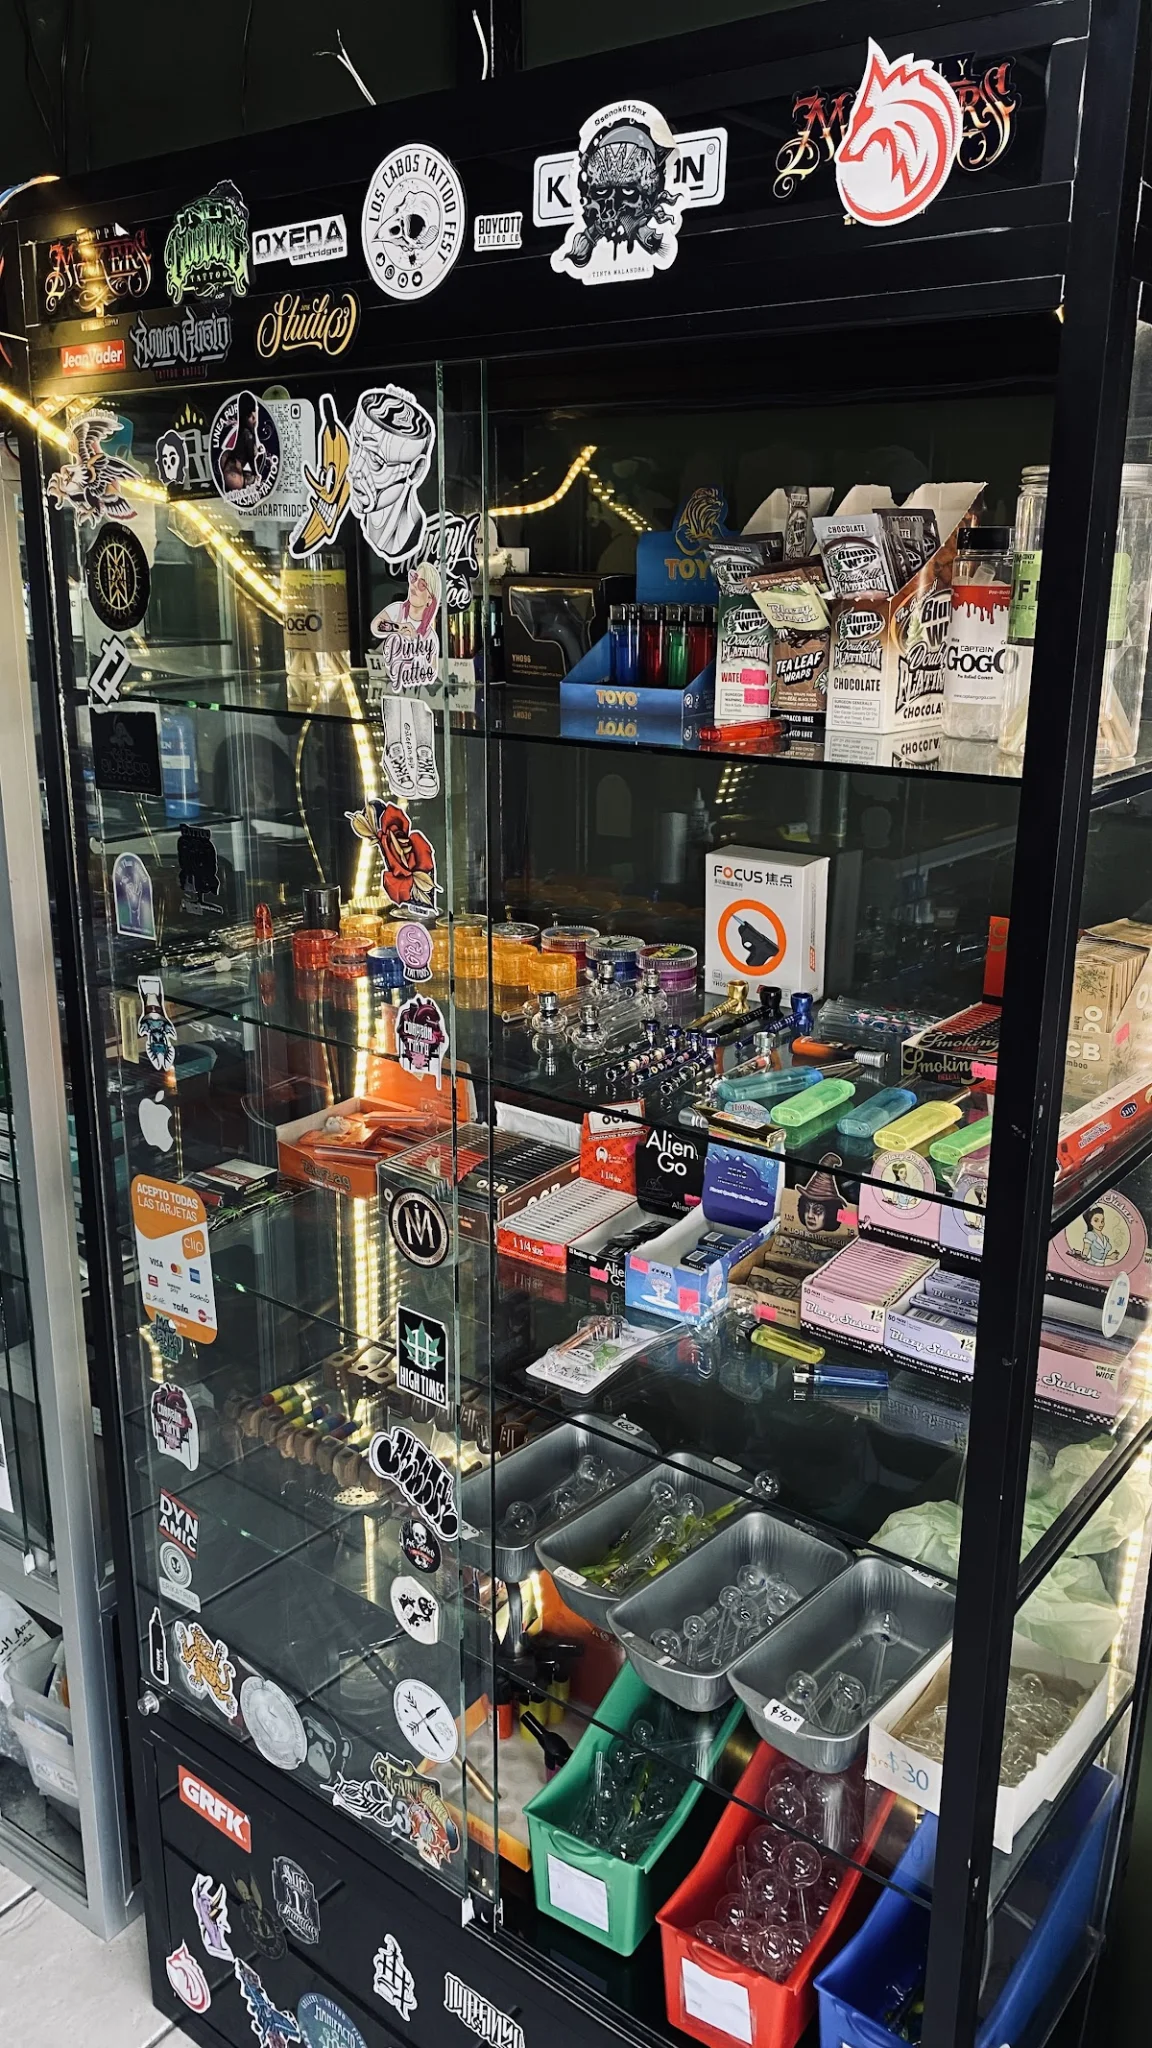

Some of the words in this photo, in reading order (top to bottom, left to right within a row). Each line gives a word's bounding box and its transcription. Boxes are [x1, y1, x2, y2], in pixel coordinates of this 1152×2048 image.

[382, 154, 420, 188] CABOS
[424, 157, 457, 213] TATTOO
[369, 189, 386, 222] LOS
[478, 216, 521, 234] BOYCOTT
[437, 221, 457, 265] FEST
[478, 235, 506, 244] TATTOO
[292, 246, 344, 261] cartridges
[190, 272, 229, 283] TATTOO
[62, 346, 123, 369] JeanVader
[212, 419, 228, 448] LINEA
[224, 403, 239, 420] PUR
[827, 524, 867, 534] CHOCOLATE
[664, 558, 711, 581] TOY
[842, 555, 877, 569] Wrap
[751, 581, 760, 592] 2
[834, 576, 888, 593] PLATINUM
[849, 622, 881, 636] Wrap
[384, 634, 437, 663] Pinky
[722, 643, 769, 661] PLATINUM
[776, 659, 793, 675] TEA
[796, 652, 823, 669] LEAF
[834, 648, 882, 671] PLATINUM
[389, 661, 436, 694] Tattoo
[784, 668, 812, 683] WRAPS
[833, 677, 881, 692] CHOCOLATE
[596, 689, 638, 707] TOYO
[903, 702, 943, 719] CHOCOLA
[713, 865, 763, 884] FOCUS
[765, 872, 793, 888] 焦点
[921, 1031, 1000, 1054] Smoking
[1067, 1059, 1089, 1070] mboo
[645, 1129, 695, 1160] Alien
[657, 1152, 687, 1177] Go
[136, 1182, 169, 1202] ACEPTO
[171, 1190, 199, 1210] TODAS
[137, 1196, 155, 1211] LAS
[155, 1199, 198, 1223] TARJETAS
[183, 1236, 204, 1254] clip
[886, 1229, 908, 1241] ROLLING
[909, 1235, 931, 1246] PAPERS
[531, 1246, 544, 1257] size
[149, 1257, 164, 1269] VISA
[604, 1261, 625, 1278] Alie
[781, 1307, 796, 1316] PAPER
[805, 1300, 838, 1323] Blazy
[838, 1312, 881, 1334] Susan
[889, 1327, 924, 1352] Blazy
[924, 1342, 969, 1363] Susan
[915, 1358, 937, 1372] ROLLING
[938, 1366, 959, 1378] PAPERS
[1095, 1370, 1115, 1382] WIDE
[400, 1365, 419, 1391] HIGH
[420, 1374, 445, 1404] TIMES
[1041, 1371, 1100, 1400] Susan
[160, 1493, 199, 1540] DYN
[159, 1514, 197, 1552] AMIC
[181, 1775, 244, 1841] GRFK
